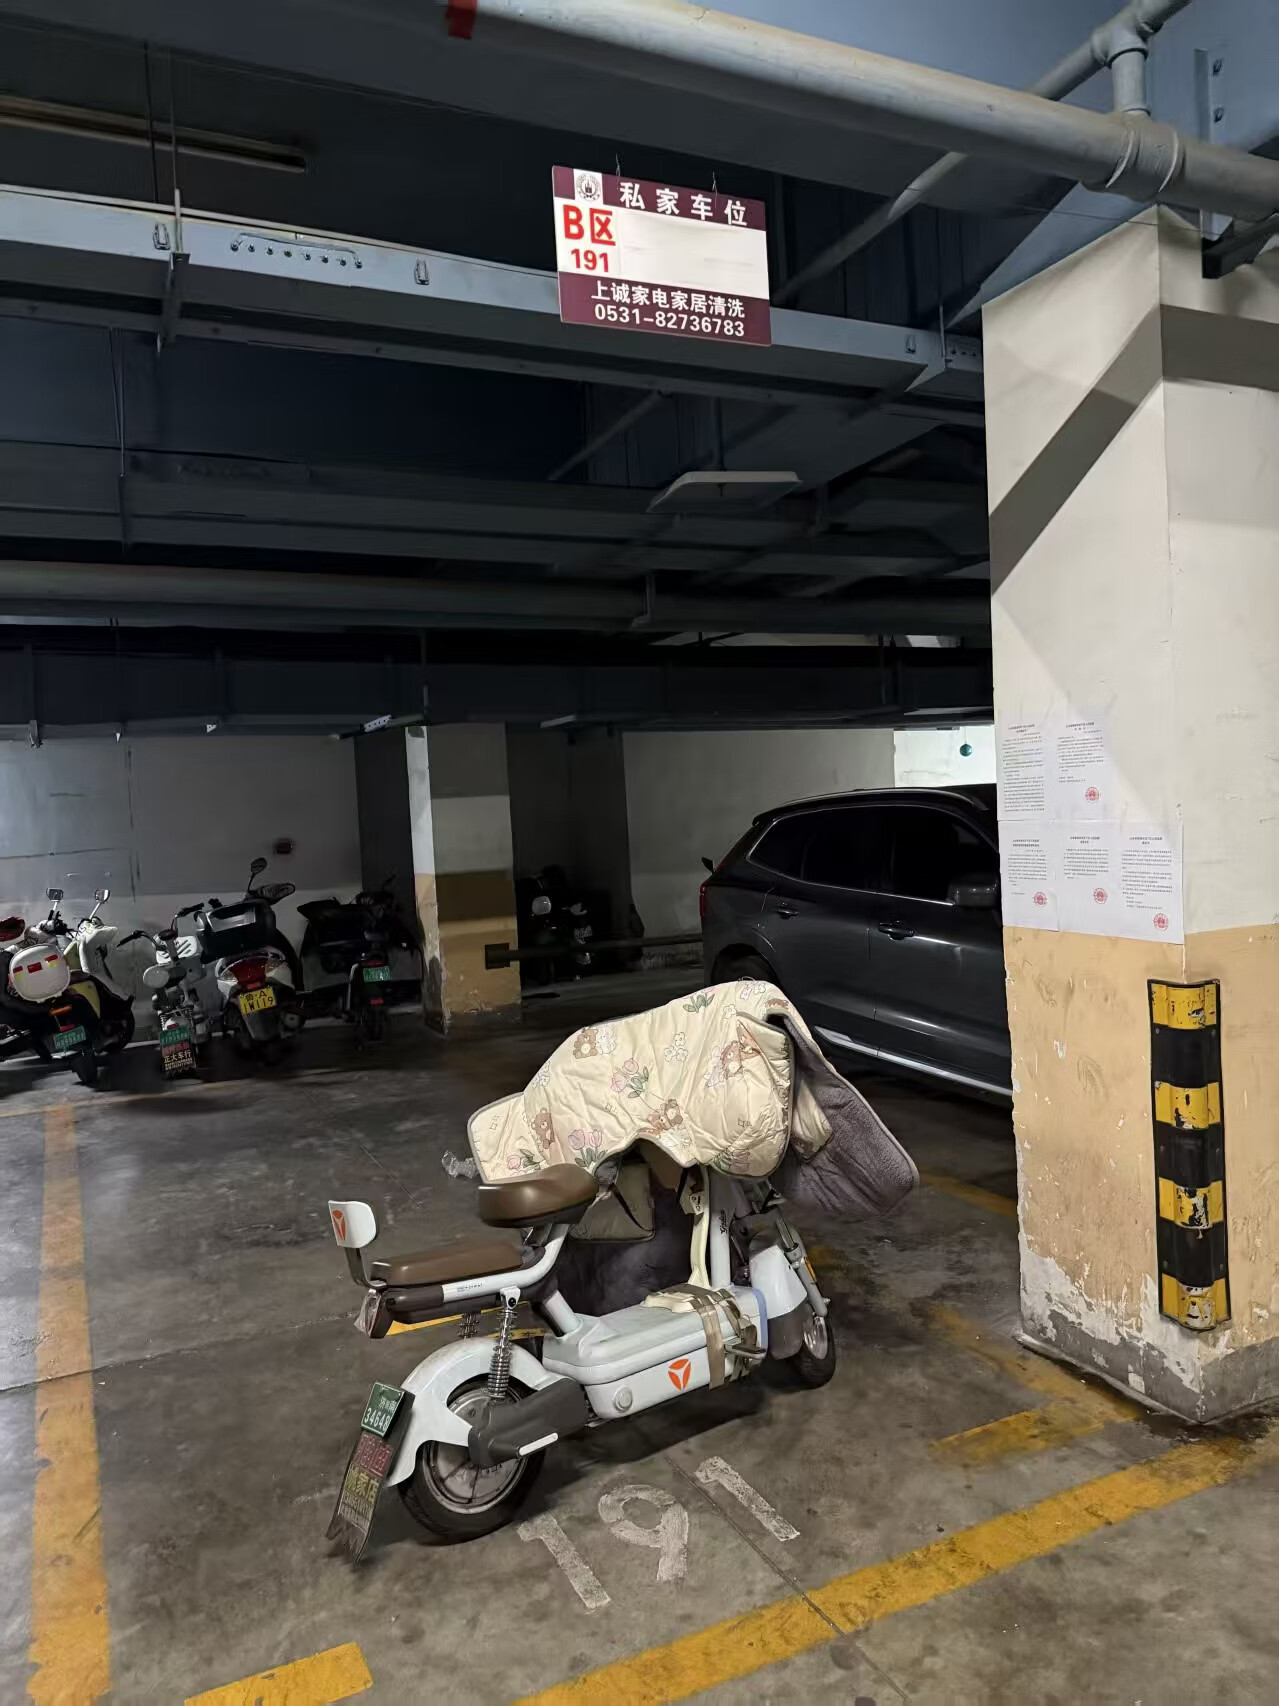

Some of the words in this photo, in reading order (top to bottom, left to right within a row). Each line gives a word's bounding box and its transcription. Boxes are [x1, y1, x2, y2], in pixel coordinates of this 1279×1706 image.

[620, 181, 747, 226] 私家车位
[562, 204, 616, 246] B区
[571, 249, 609, 272] 191
[591, 280, 745, 318] 上诚家电家居清洗
[595, 304, 745, 336] 0531-82736783
[516, 1455, 800, 1609] 191
